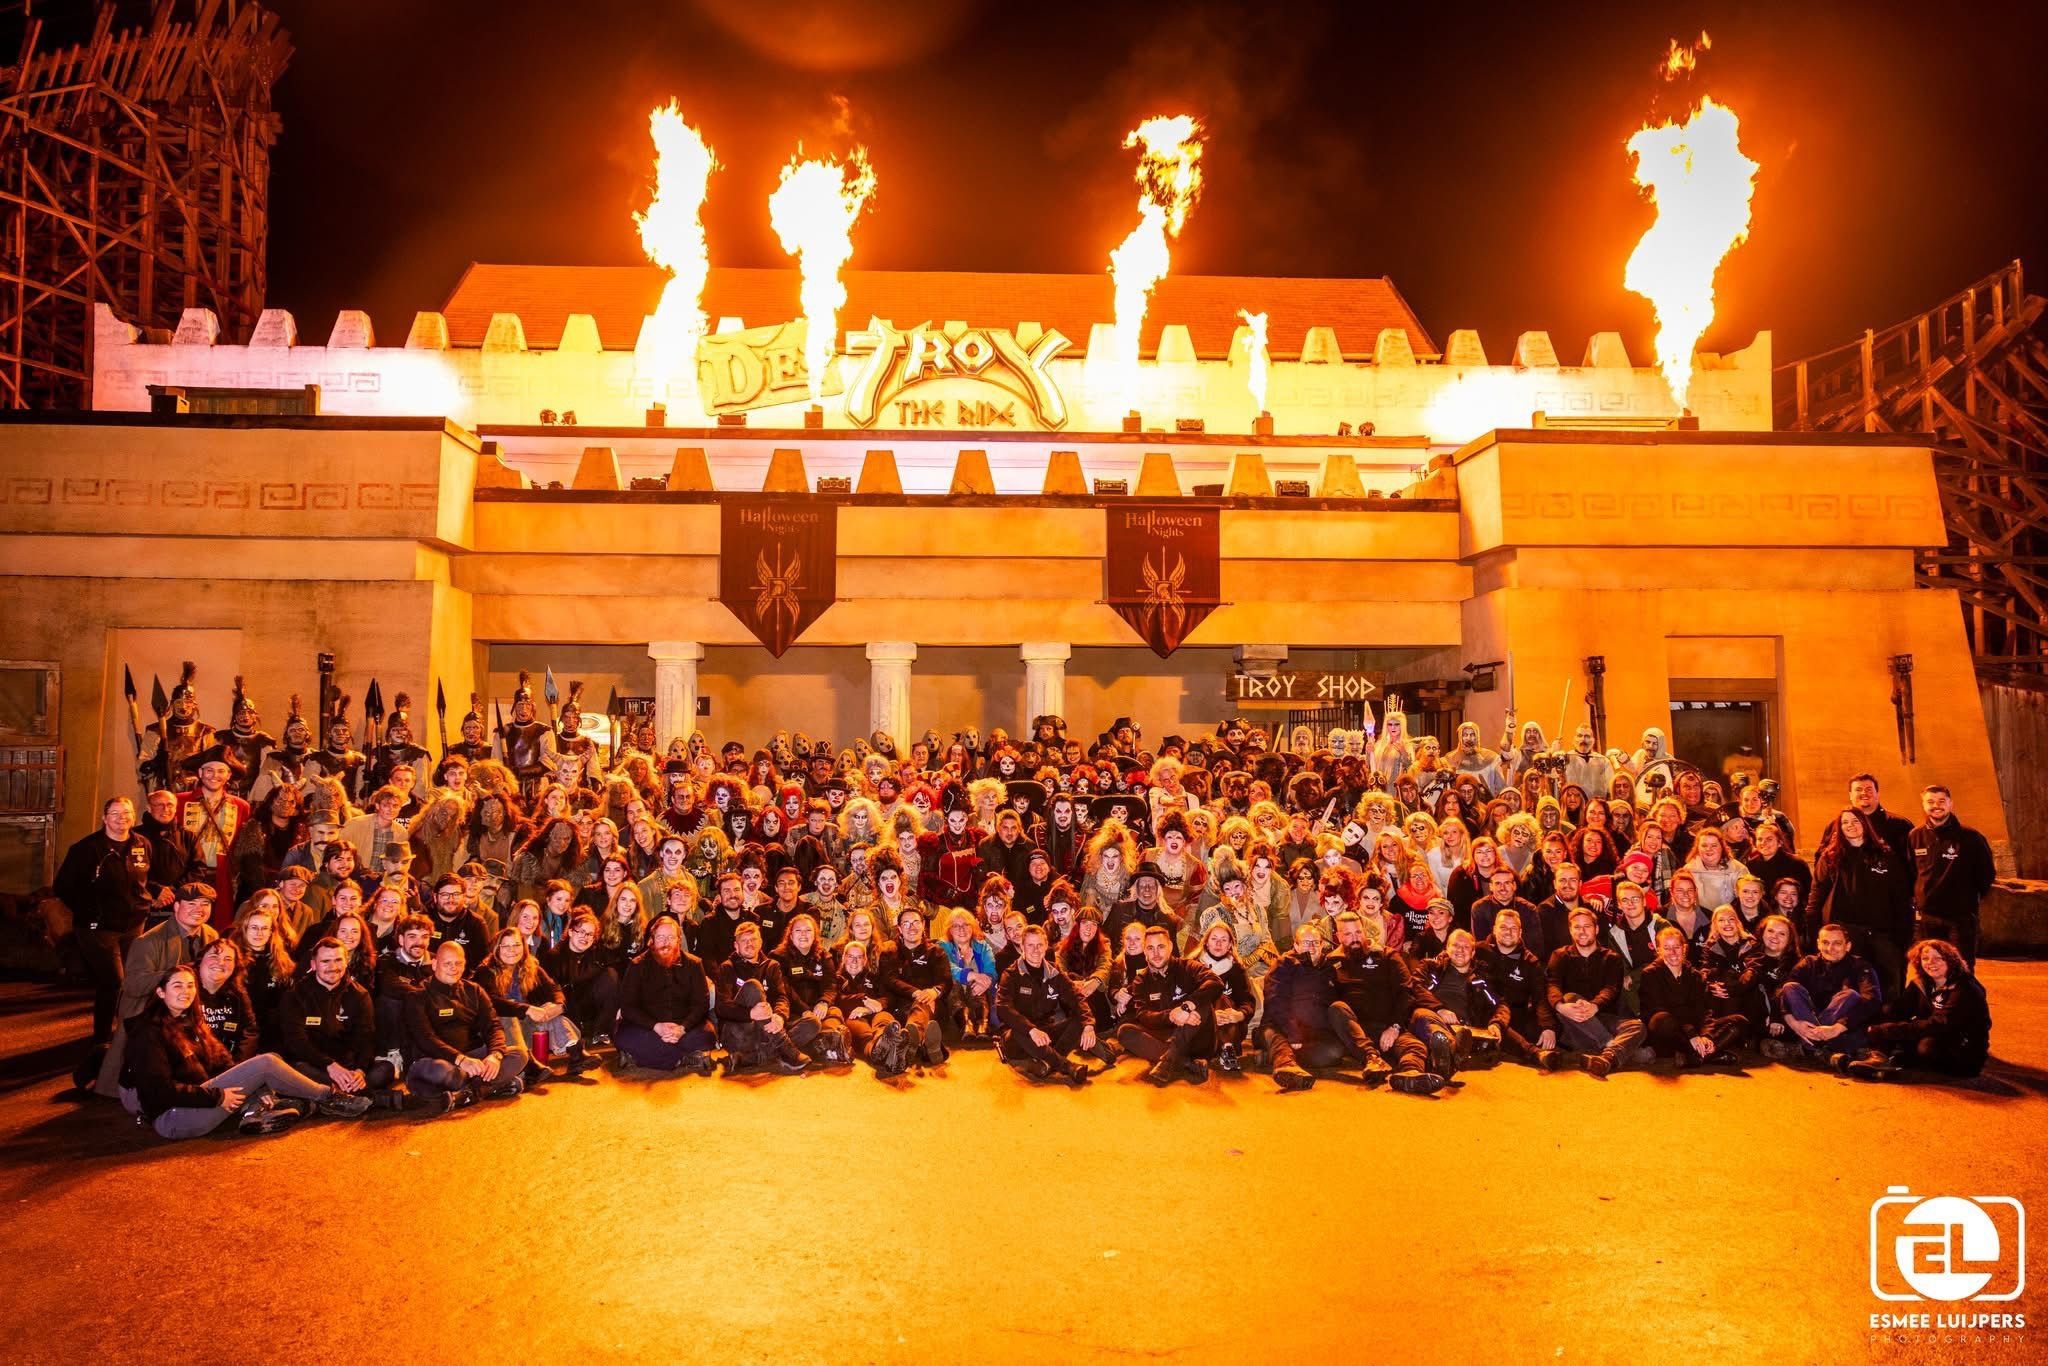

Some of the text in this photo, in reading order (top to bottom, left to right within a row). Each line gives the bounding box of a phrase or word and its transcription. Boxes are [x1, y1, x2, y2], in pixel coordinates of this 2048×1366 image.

[845, 314, 1074, 431] TROY
[895, 399, 1017, 427] THE RIDE
[740, 505, 819, 530] Halloween
[1125, 509, 1202, 534] Halloween
[1152, 527, 1184, 538] Nights
[1234, 674, 1376, 699] TROY SHOP
